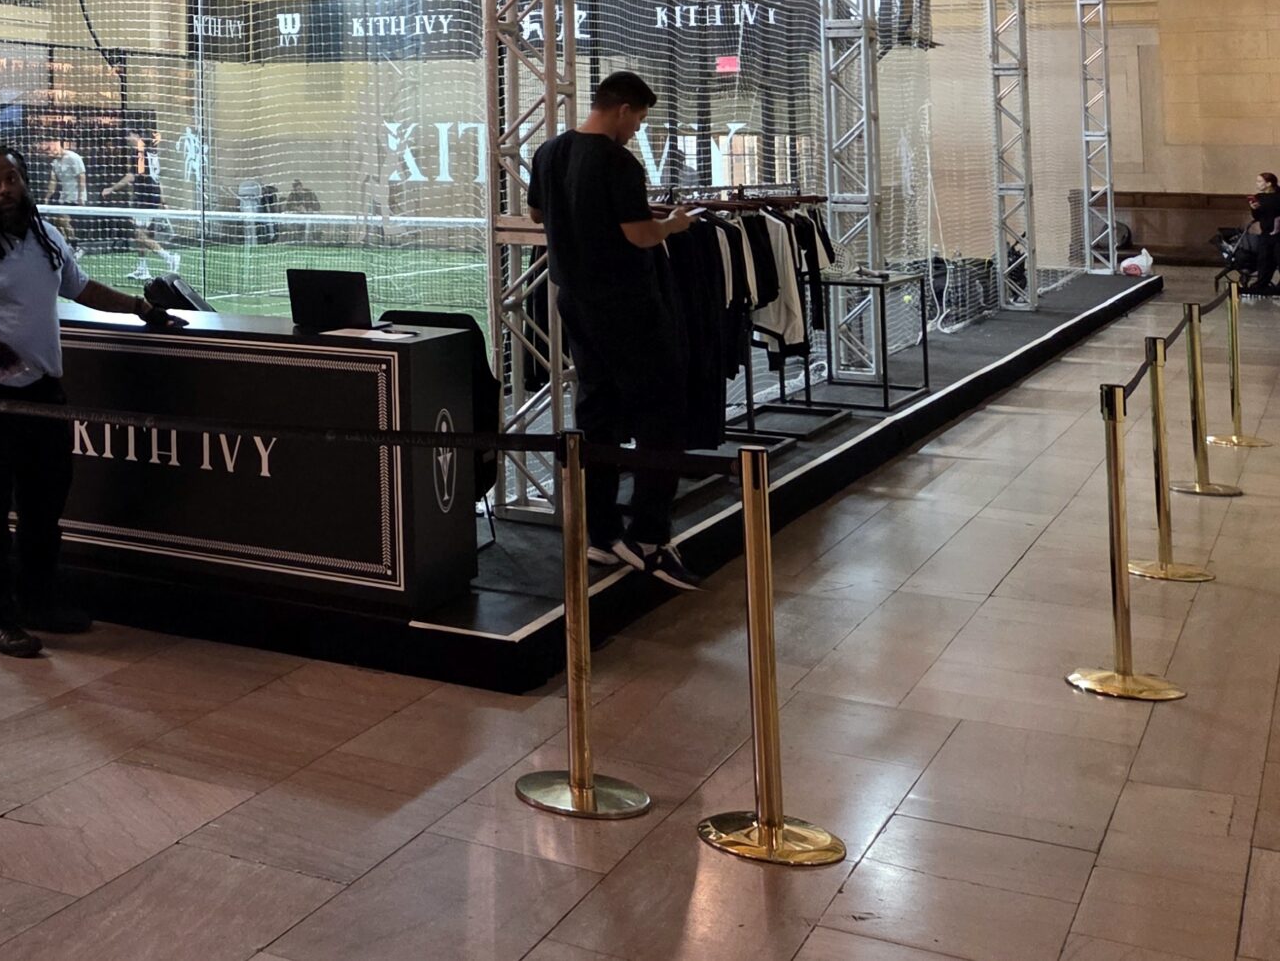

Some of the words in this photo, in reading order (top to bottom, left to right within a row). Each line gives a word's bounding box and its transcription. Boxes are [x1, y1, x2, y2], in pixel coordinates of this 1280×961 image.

[351, 15, 406, 37] KITH
[414, 14, 453, 35] IVY
[655, 3, 723, 29] KITH
[226, 19, 244, 39] IVY
[280, 34, 300, 47] IVY
[71, 419, 181, 467] KITH
[200, 431, 278, 478] IVY
